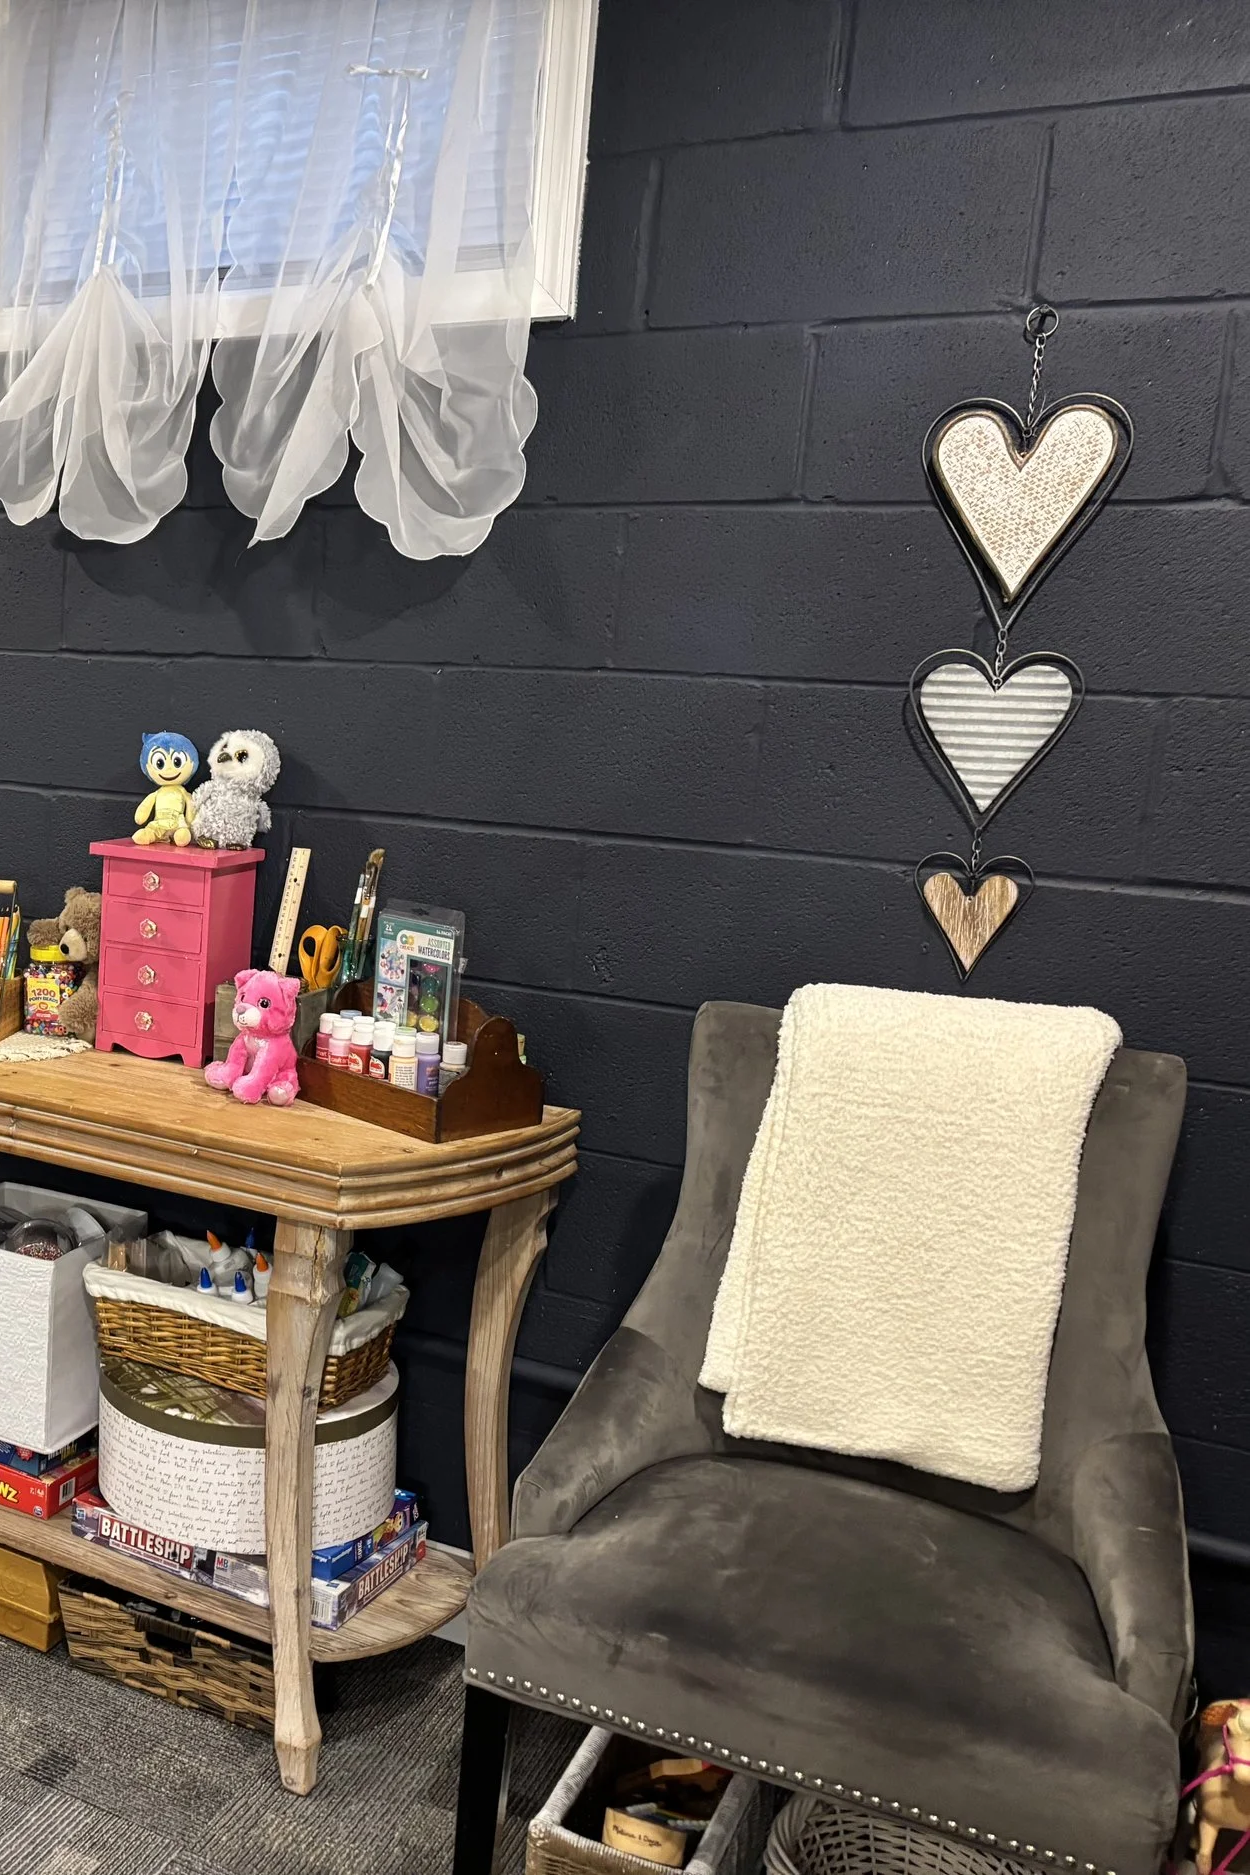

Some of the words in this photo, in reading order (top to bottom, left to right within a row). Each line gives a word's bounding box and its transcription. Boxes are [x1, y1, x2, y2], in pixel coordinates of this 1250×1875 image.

[428, 938, 450, 951] ASSORTED
[418, 945, 450, 960] WATERCOLORS
[31, 988, 56, 998] 1200
[43, 996, 58, 1004] BEADS
[101, 1517, 191, 1564] BATTLESHIP
[217, 1556, 229, 1568] MB
[358, 1542, 408, 1600] BATTLESHIP
